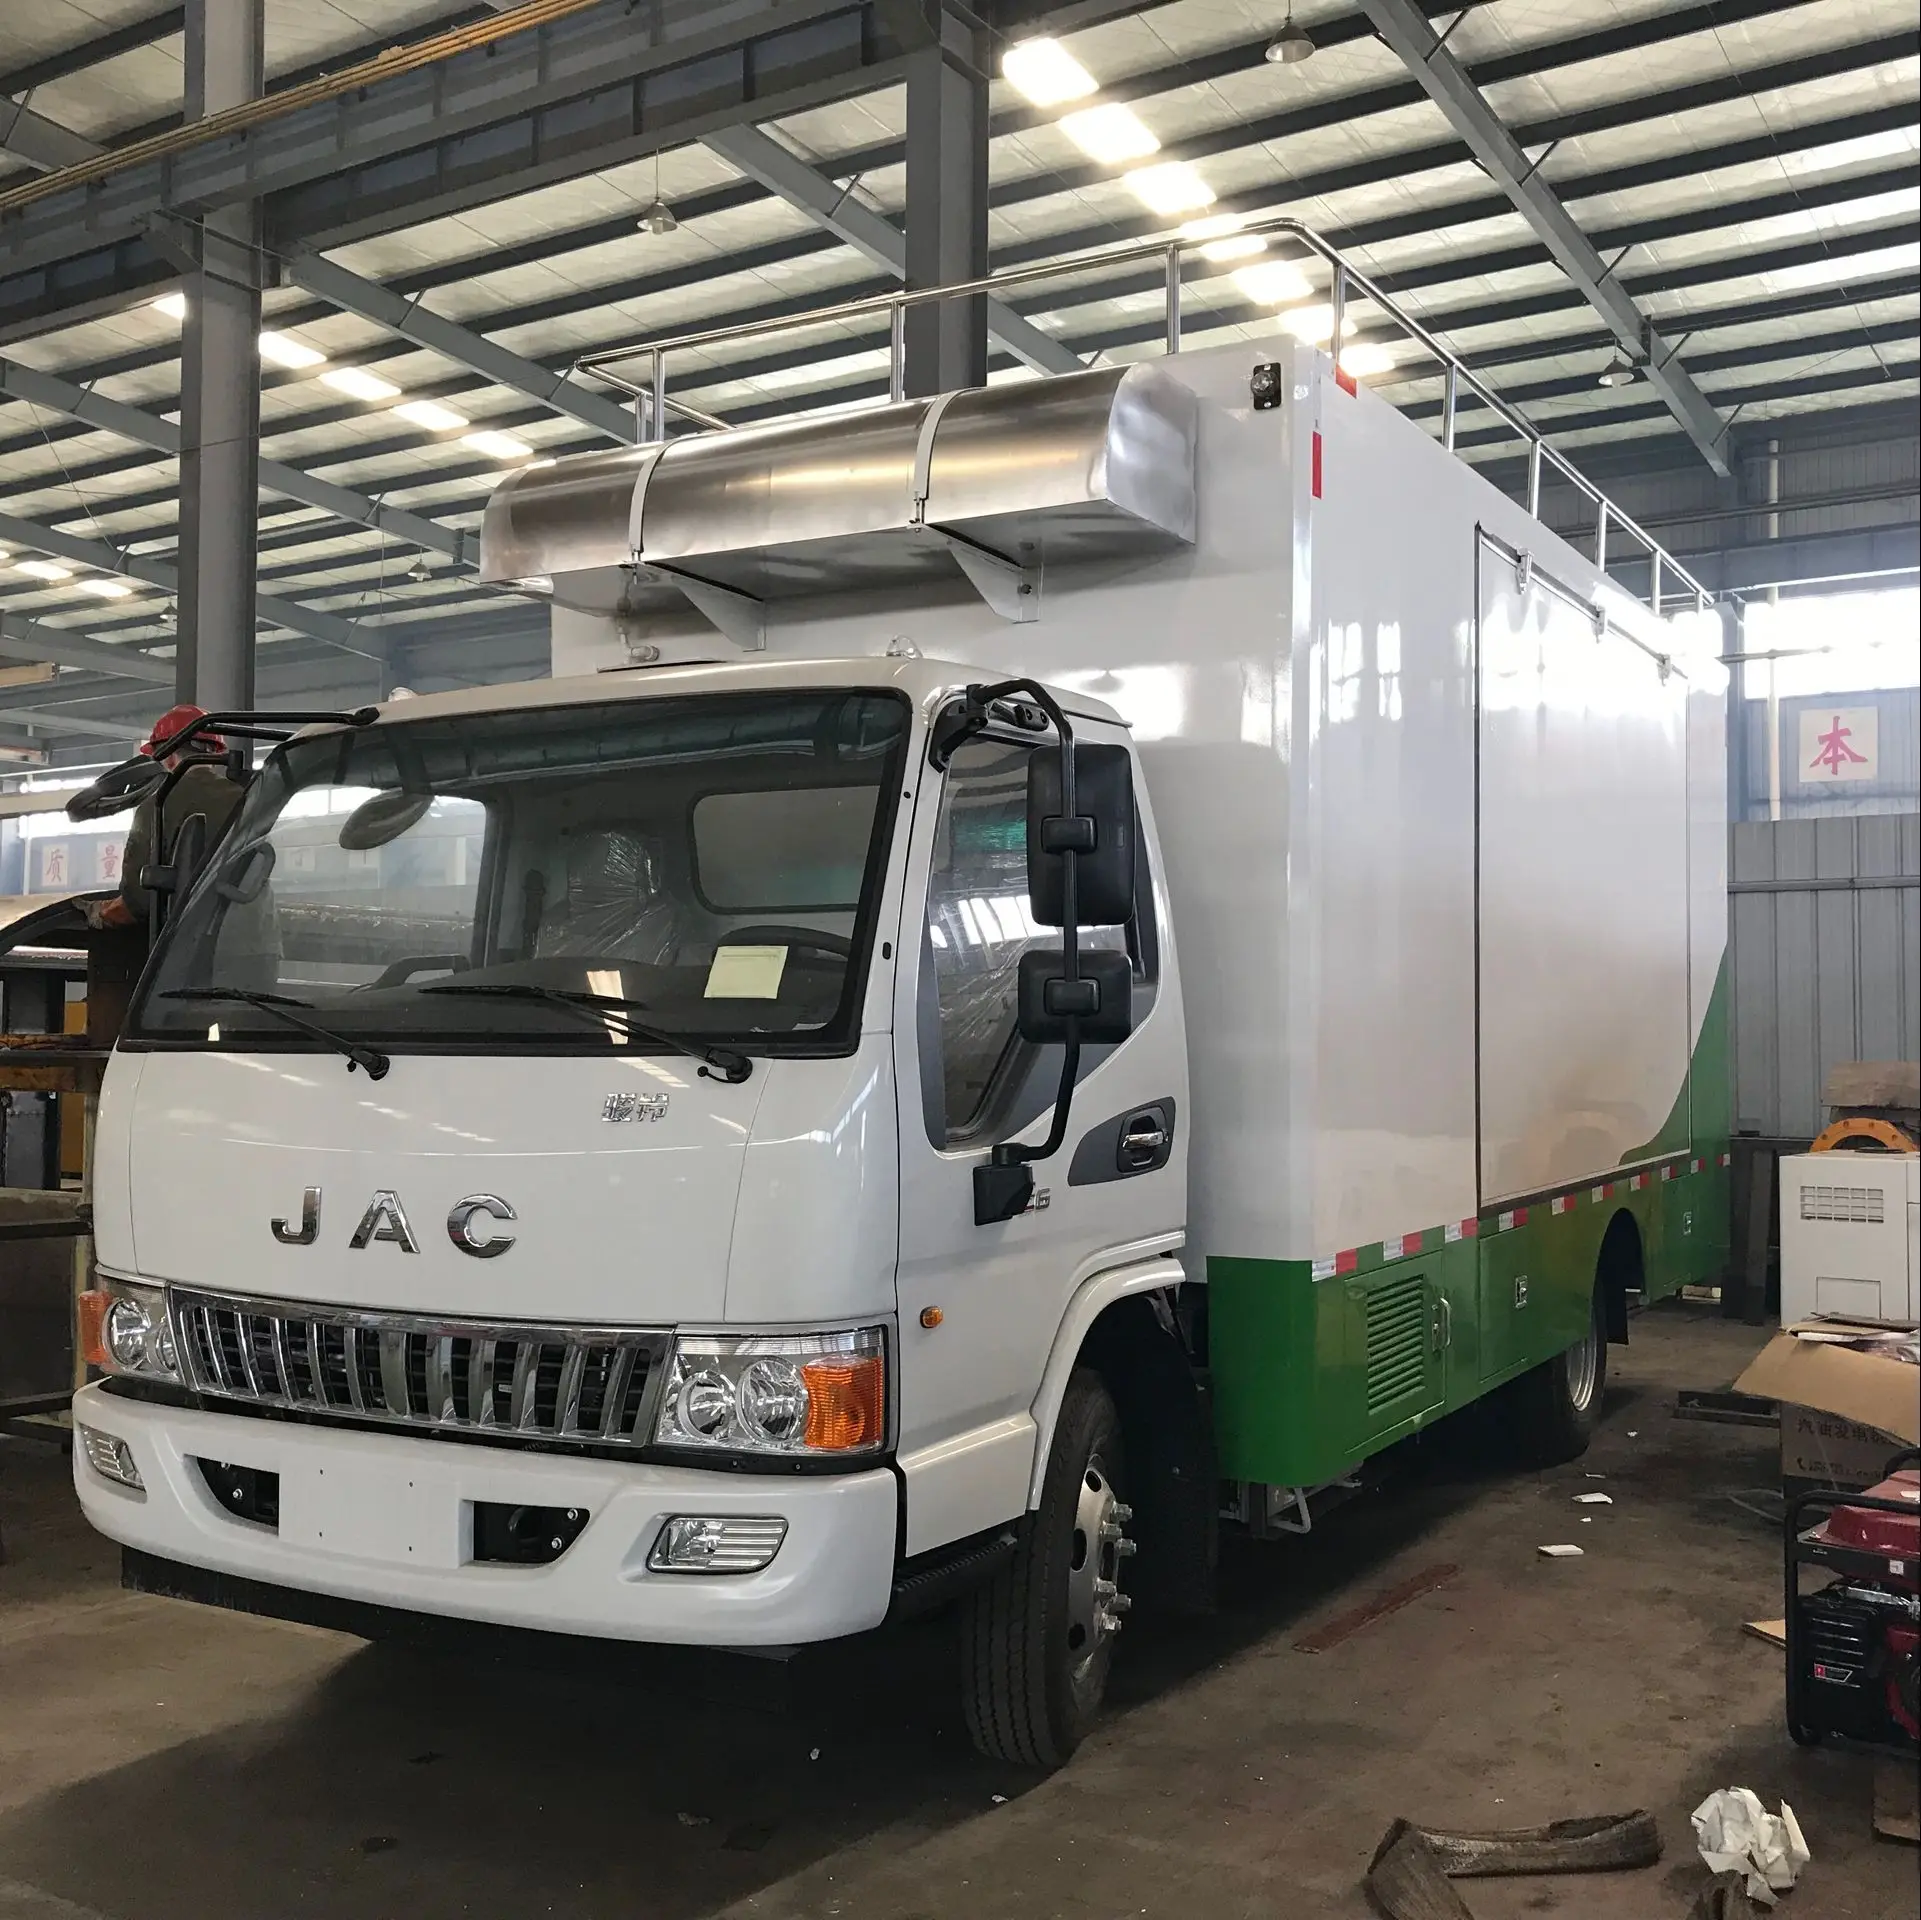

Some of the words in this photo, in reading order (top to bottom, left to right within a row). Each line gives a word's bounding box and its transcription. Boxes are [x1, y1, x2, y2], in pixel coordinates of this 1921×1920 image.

[1809, 715, 1869, 776] 本
[101, 844, 119, 880] 量
[270, 1186, 518, 1259] JAC
